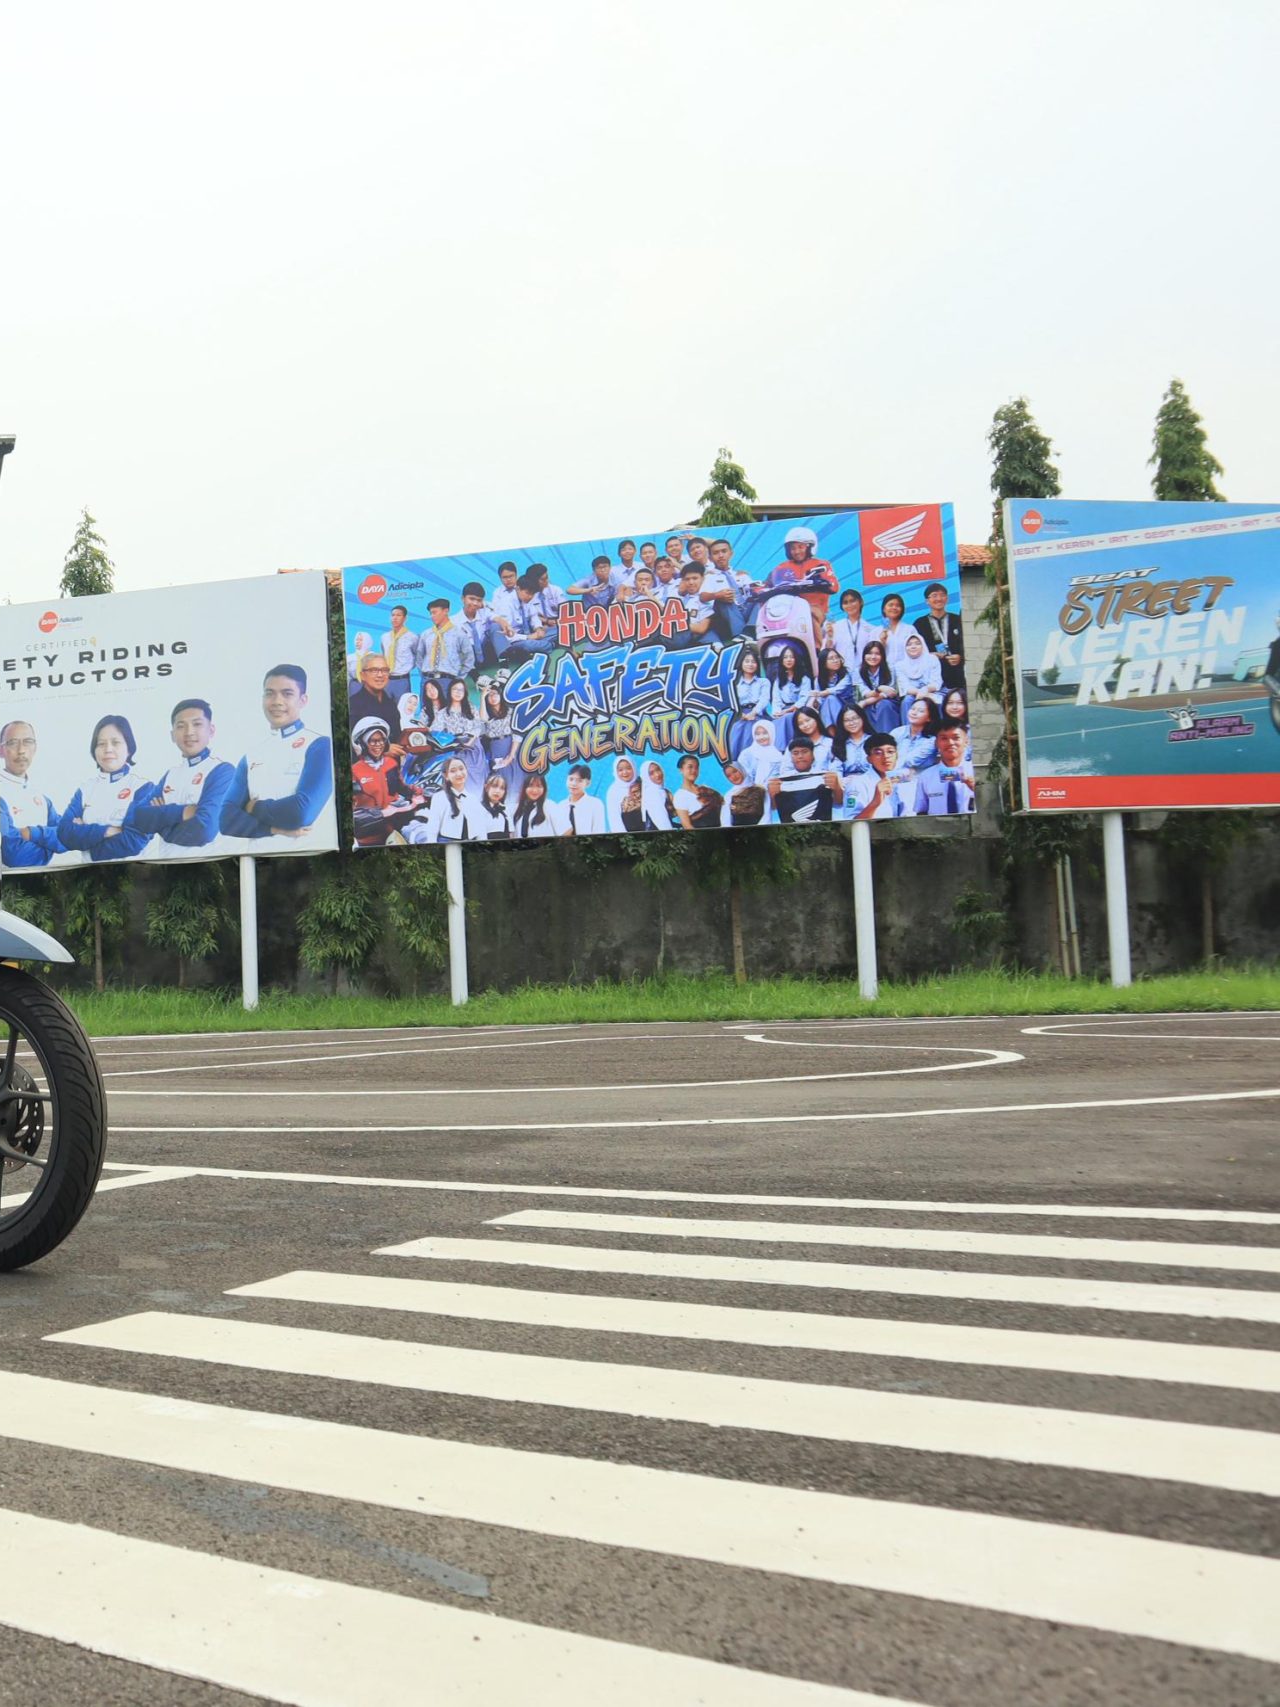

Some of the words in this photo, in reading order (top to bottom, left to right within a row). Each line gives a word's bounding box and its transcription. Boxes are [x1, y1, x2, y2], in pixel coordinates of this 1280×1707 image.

[873, 547, 931, 559] HONDA
[874, 568, 896, 578] One
[896, 563, 933, 576] HEART.
[361, 584, 385, 594] DAYA
[388, 581, 424, 592] Adicipta
[558, 599, 689, 646] HONDA
[1058, 575, 1237, 635] STREET
[26, 637, 88, 652] CERTIFIED
[78, 641, 188, 664] RIDING
[1040, 605, 1247, 671] KEREN
[504, 641, 745, 733] SAFETY
[1075, 651, 1219, 706] KAN!
[520, 710, 735, 774] GENERATION
